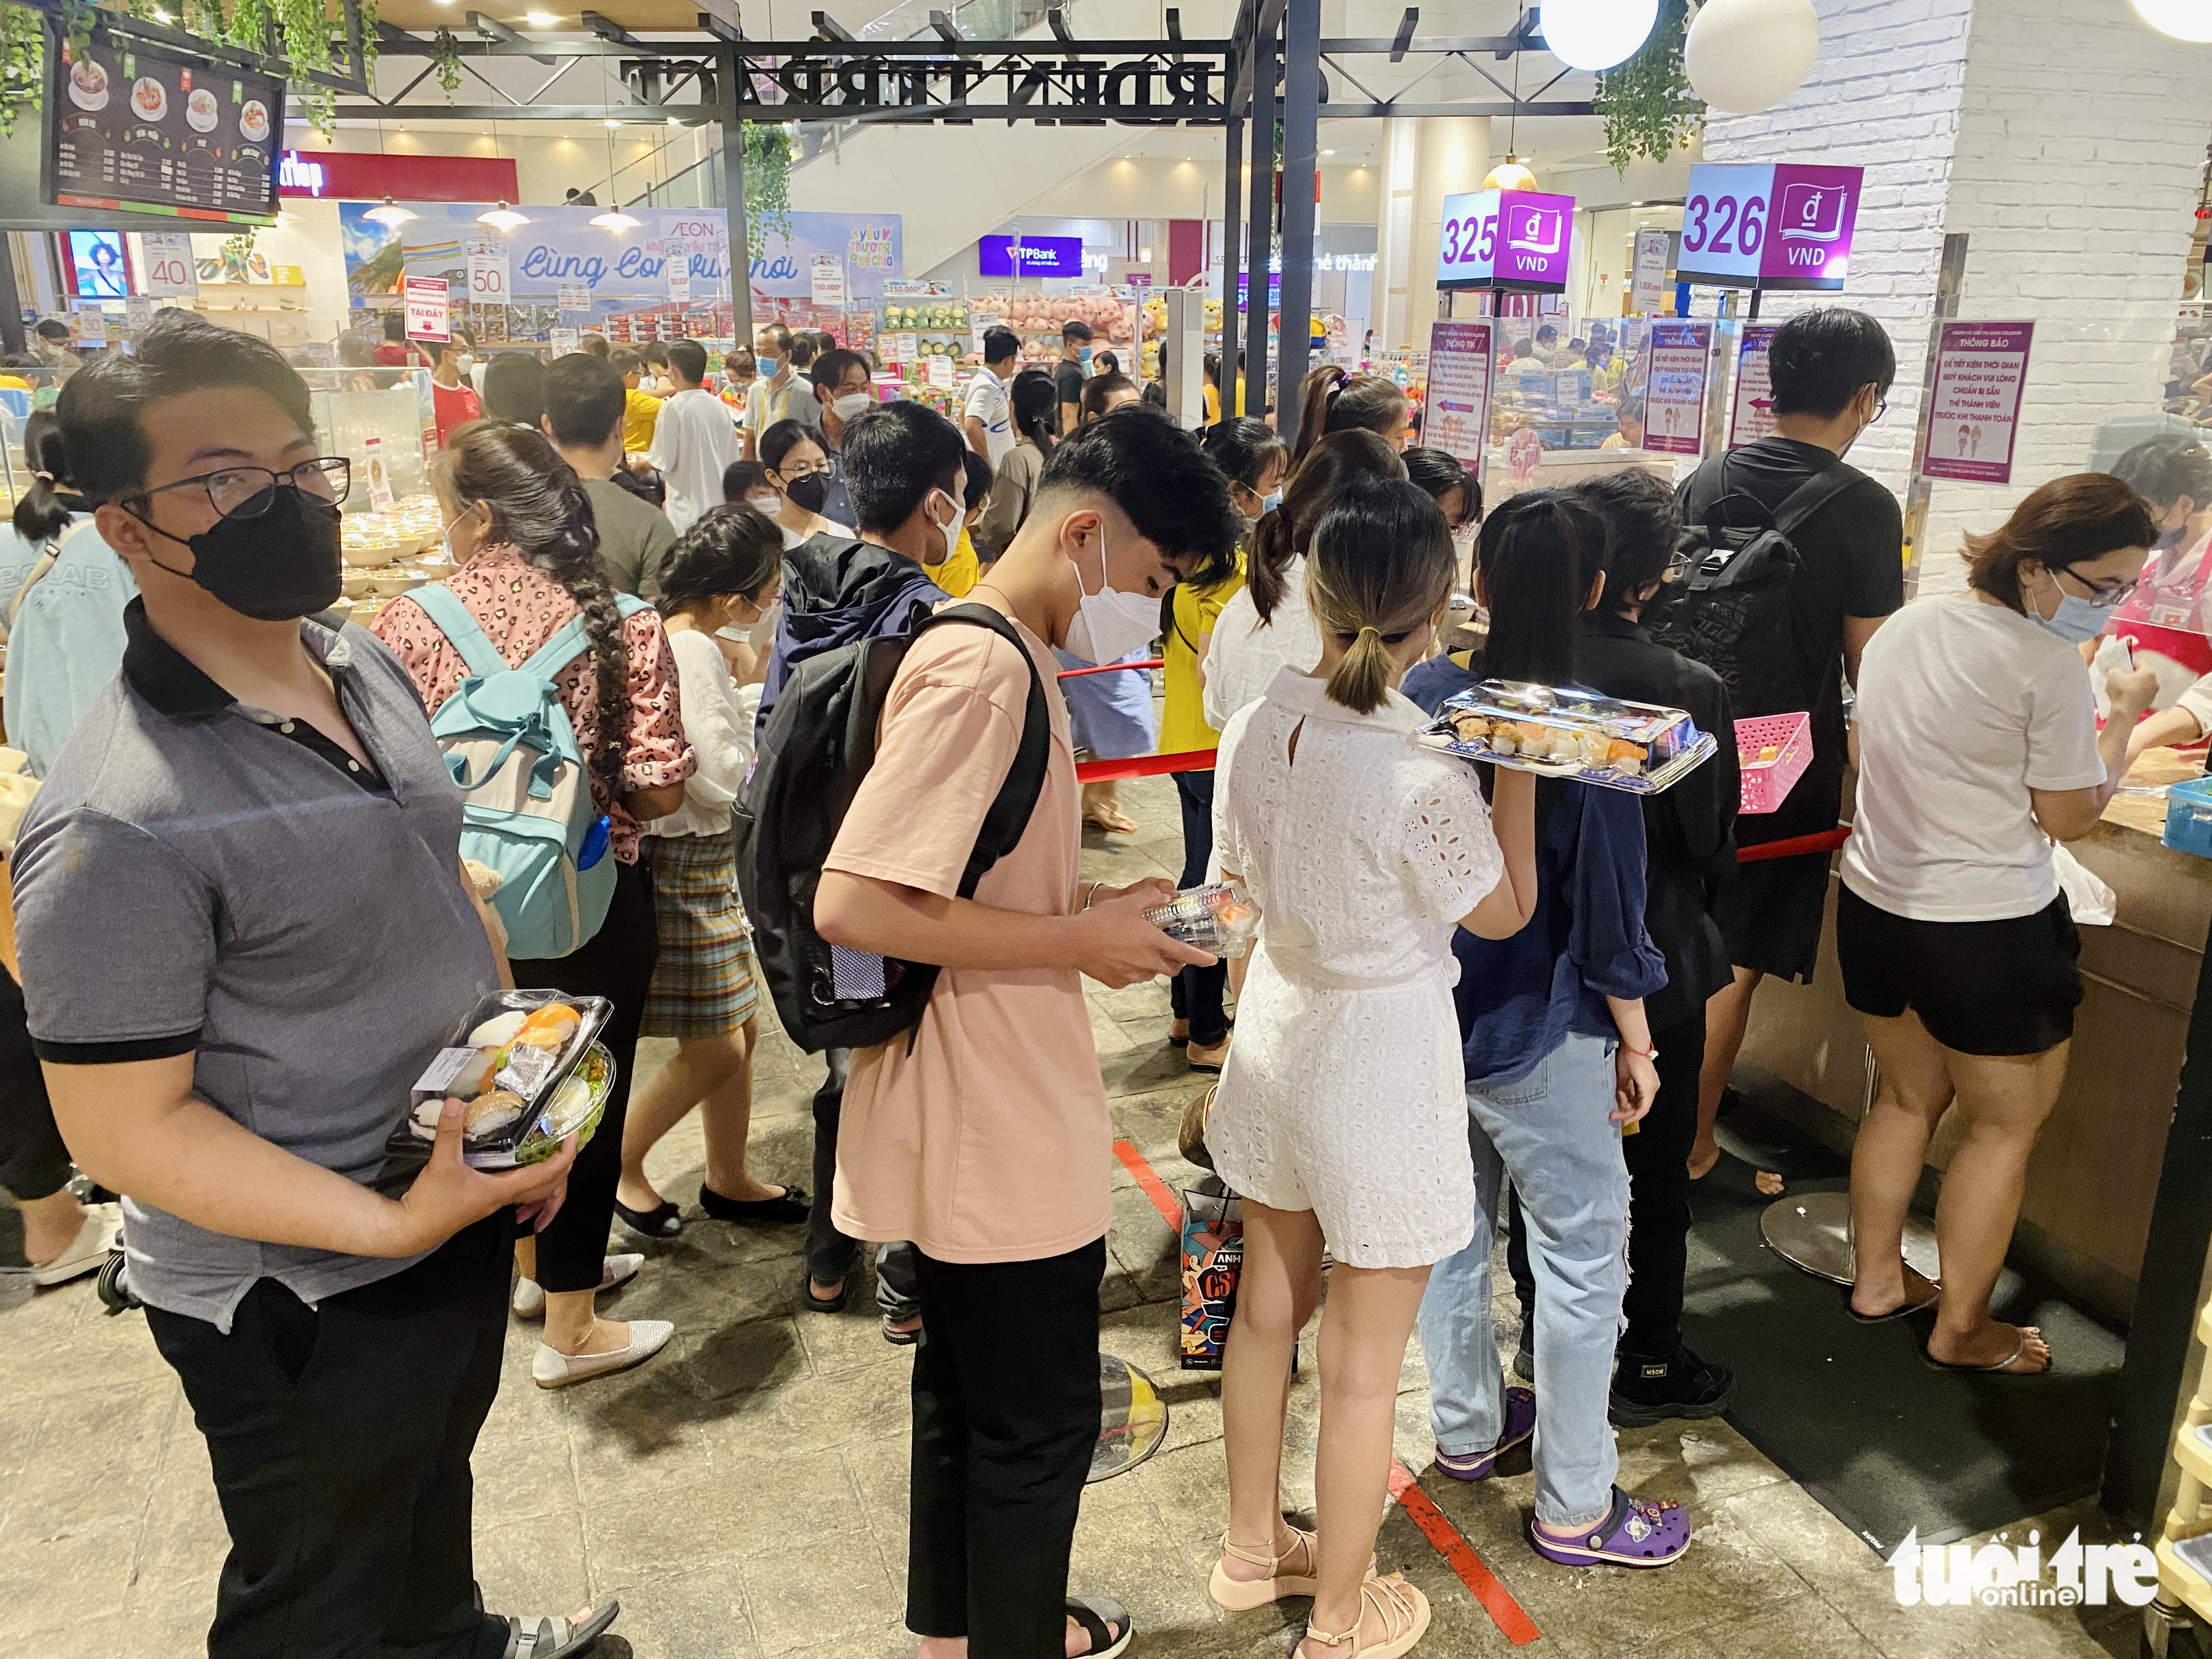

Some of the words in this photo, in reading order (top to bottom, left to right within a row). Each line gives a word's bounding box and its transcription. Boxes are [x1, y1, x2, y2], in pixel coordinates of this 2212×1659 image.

[1684, 195, 1765, 256] 326
[860, 225, 880, 242] yêu
[1443, 215, 1498, 264] 325
[1019, 248, 1057, 259] TPBank
[1788, 247, 1825, 266] VND
[520, 245, 607, 289] Cùng
[872, 256, 893, 267] chia
[1516, 255, 1548, 272] VND
[1960, 337, 1989, 347] THÔNG
[1990, 337, 2008, 347] BÁO
[1954, 358, 1966, 368] TIẾT
[1966, 359, 1982, 370] KIỆM
[1984, 359, 1999, 369] THỜI
[1943, 372, 1957, 380] QUÝ
[1958, 372, 1982, 381] KHÁCH
[1996, 374, 2016, 382] LÒNG
[1978, 387, 1984, 397] BỊ
[1962, 399, 1984, 408] THÀNH
[1970, 414, 1991, 422] THANH
[1993, 414, 2012, 422] TOÁN
